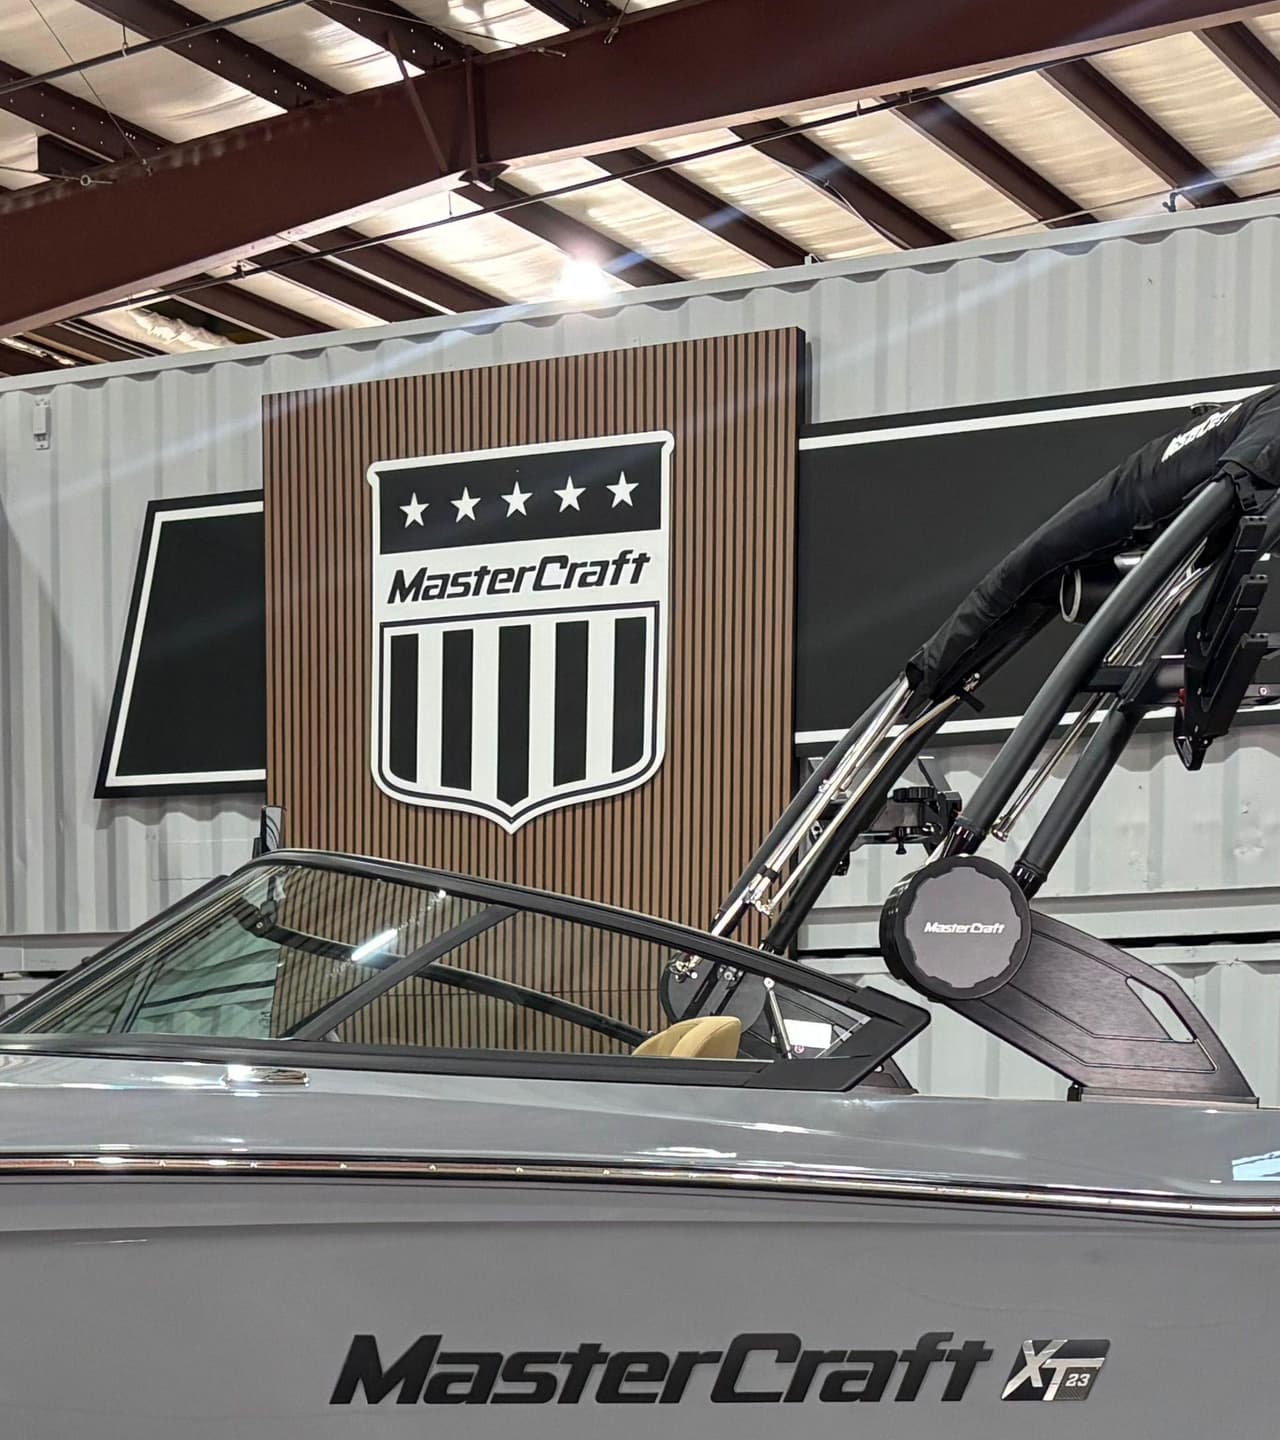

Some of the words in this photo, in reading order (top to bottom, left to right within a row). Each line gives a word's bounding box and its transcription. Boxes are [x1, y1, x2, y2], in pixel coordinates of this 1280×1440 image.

[386, 549, 651, 605] MasterCraft
[923, 921, 1006, 934] MasterCraft
[328, 1331, 994, 1405] MasterCraft
